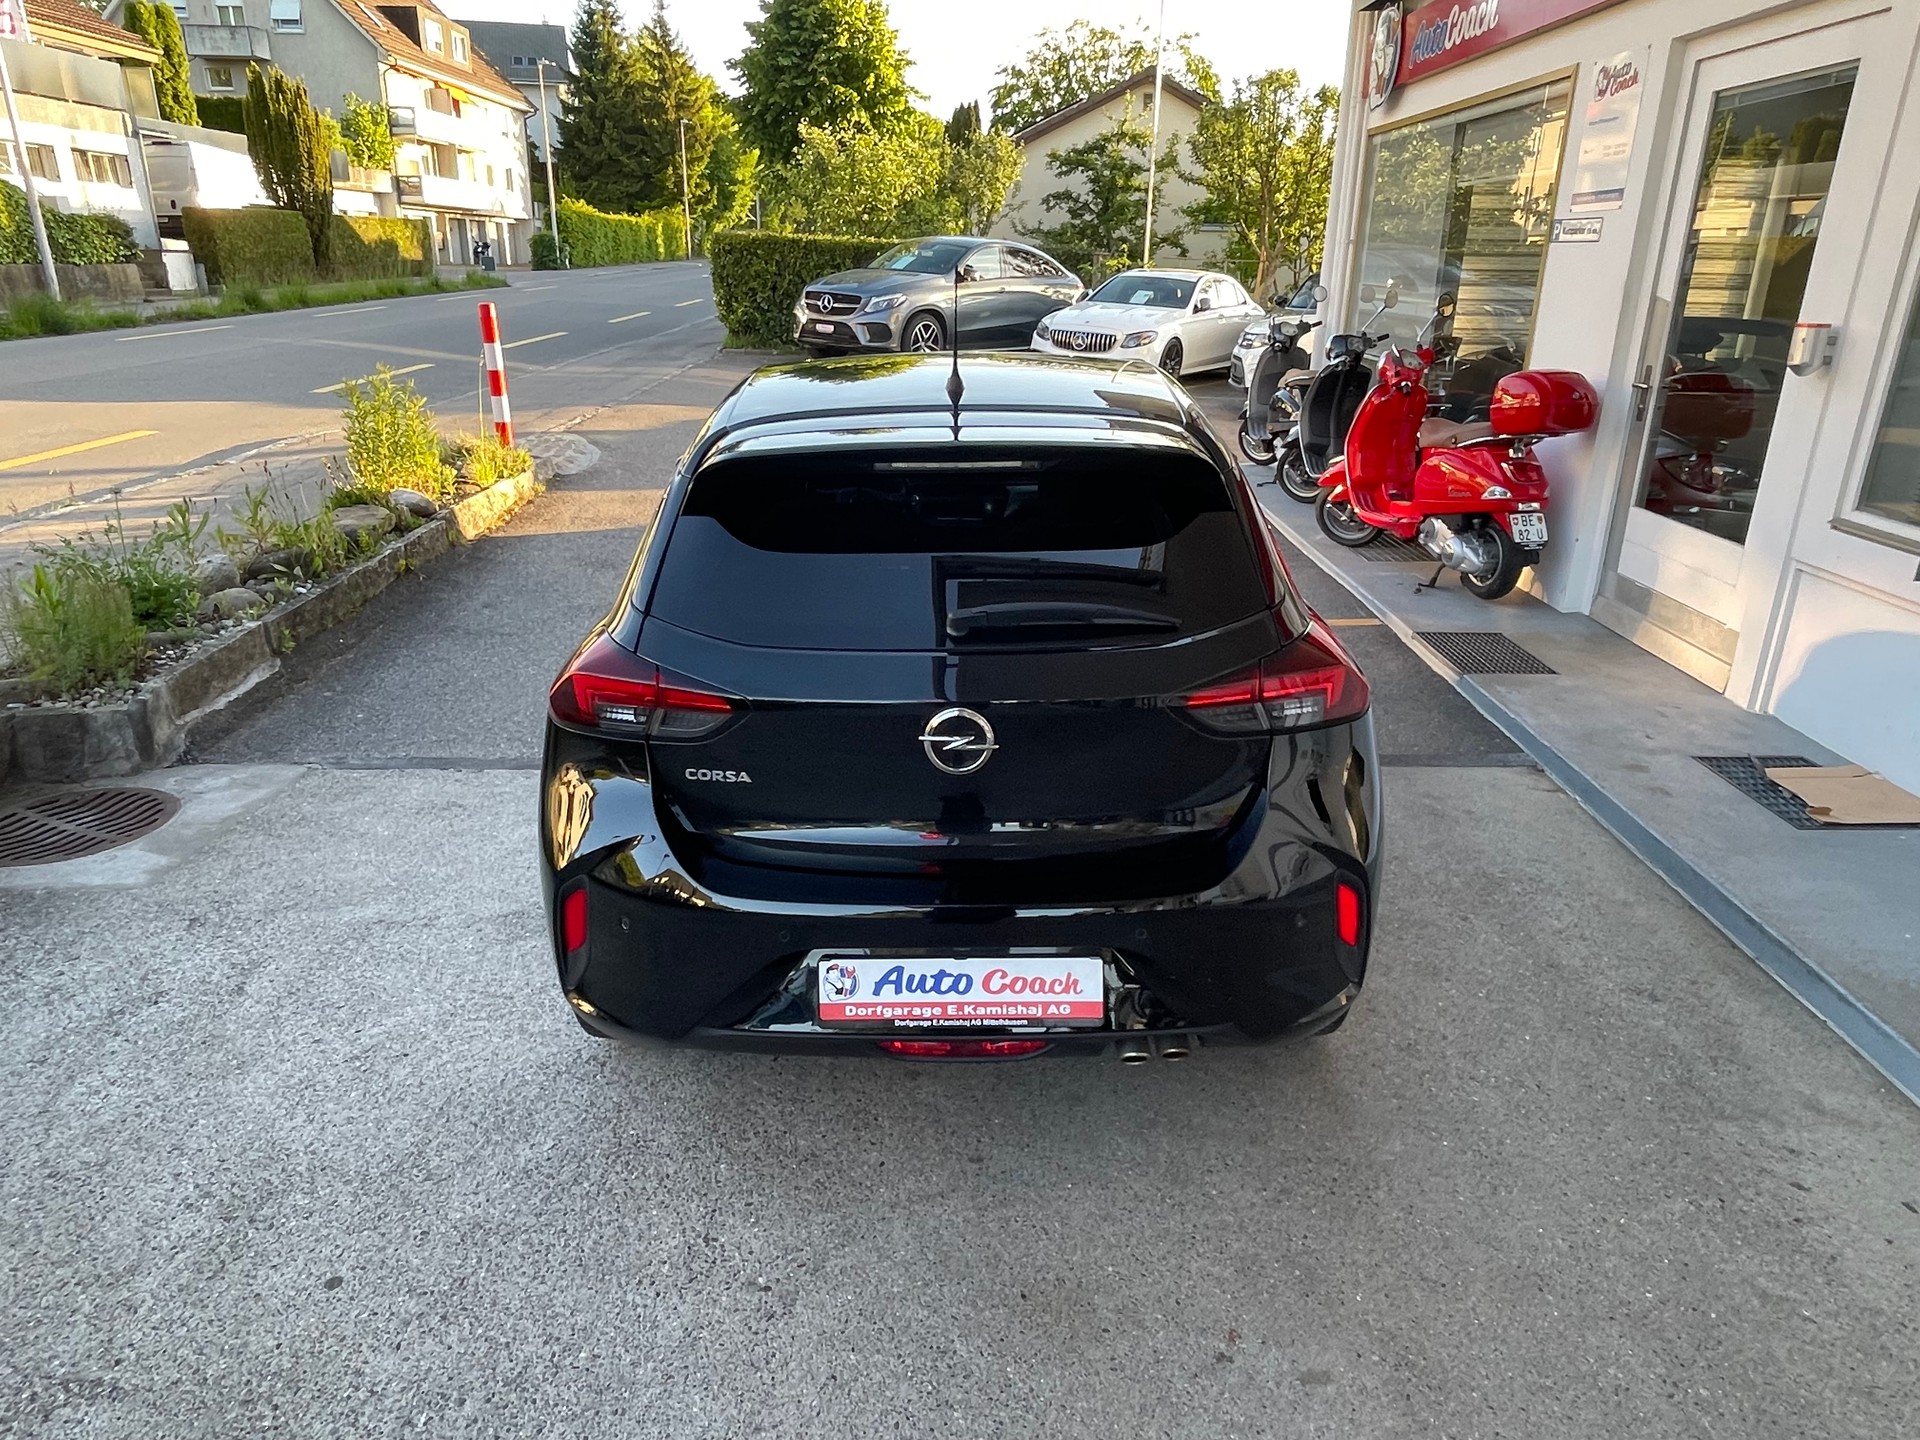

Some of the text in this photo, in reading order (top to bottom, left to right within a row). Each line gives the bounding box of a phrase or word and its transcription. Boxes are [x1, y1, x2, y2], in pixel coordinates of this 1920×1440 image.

[1609, 67, 1639, 97] Coach
[1521, 515, 1535, 527] BE
[1518, 529, 1531, 541] 82
[685, 768, 753, 783] CORSA
[872, 965, 1084, 996] Auto Coach
[845, 1004, 1072, 1018] Dorfgarage E.Kamishaj AG
